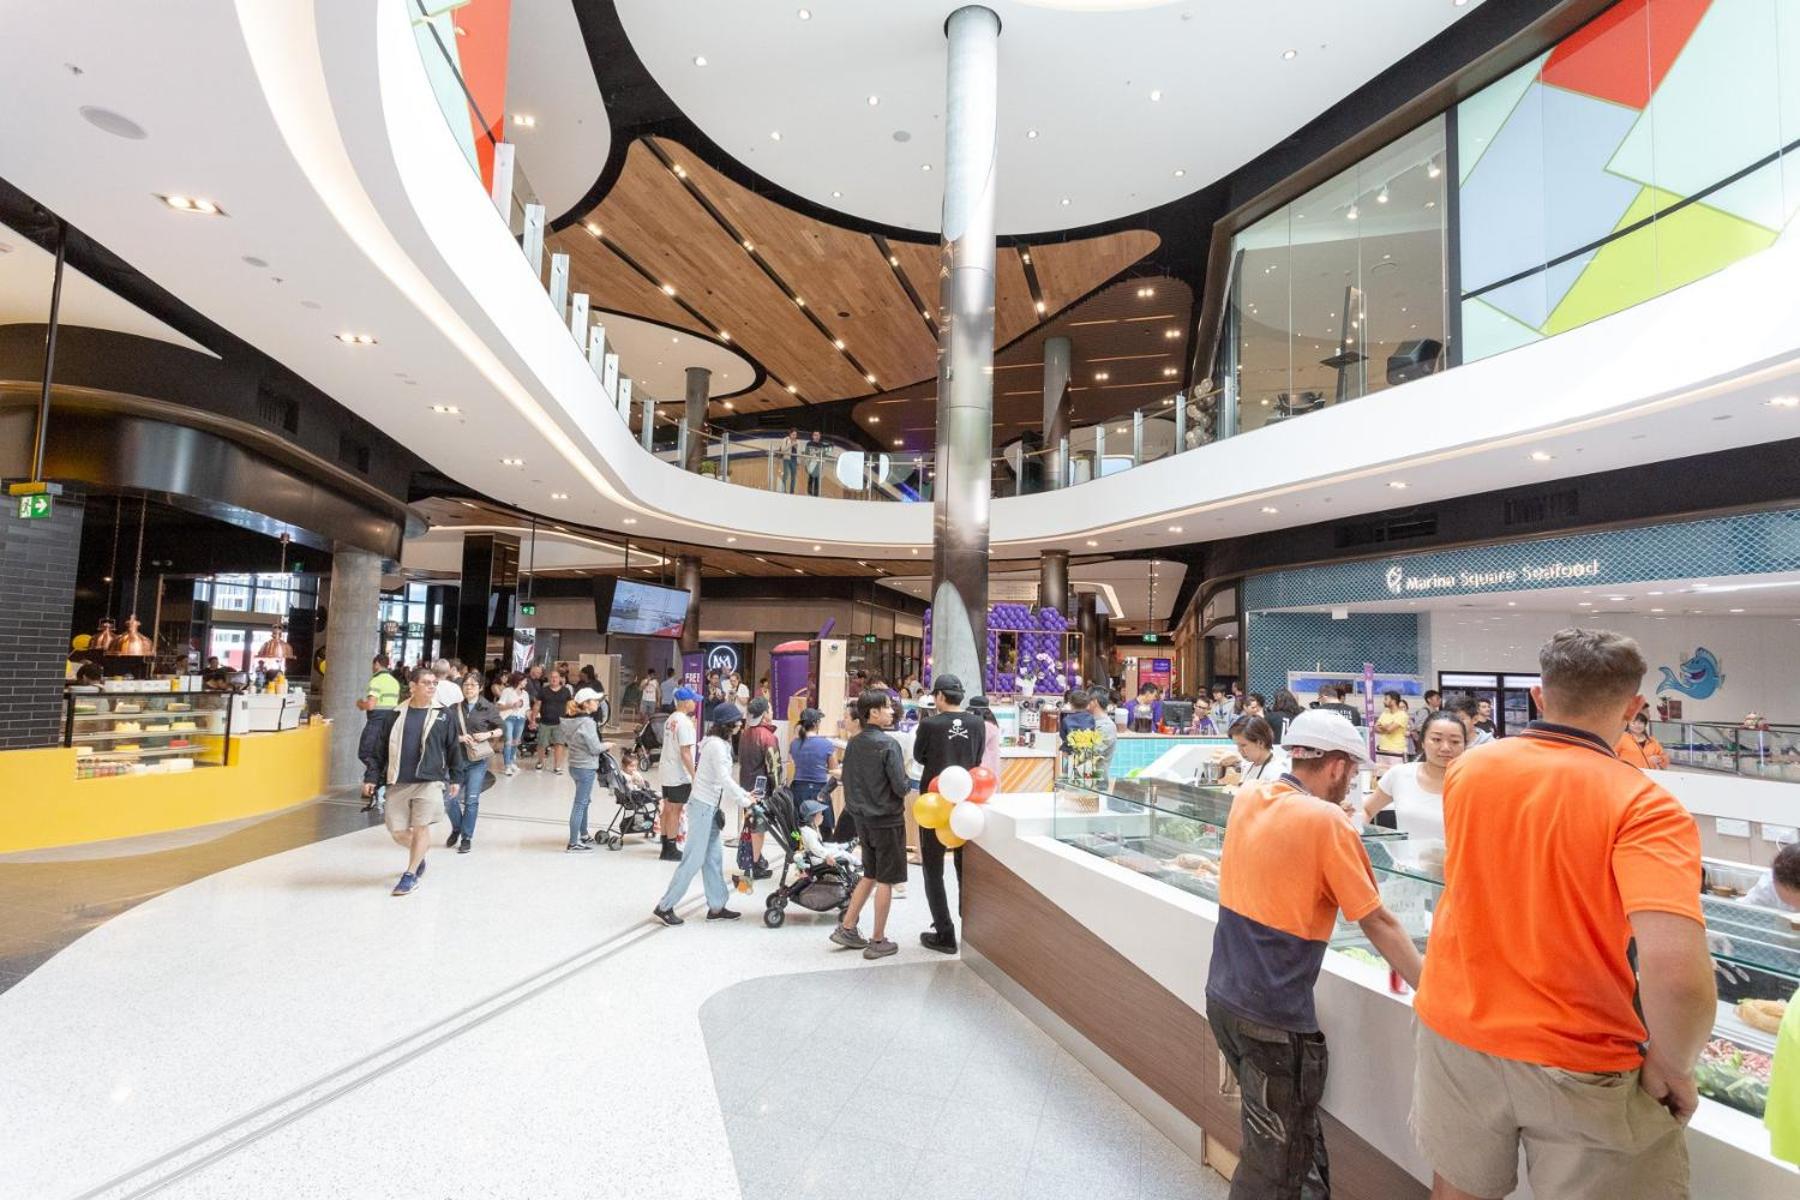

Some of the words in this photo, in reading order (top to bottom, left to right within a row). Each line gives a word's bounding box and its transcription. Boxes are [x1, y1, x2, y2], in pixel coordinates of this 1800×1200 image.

[1406, 573, 1455, 590] Marina
[1460, 570, 1516, 588] Square
[1522, 559, 1600, 580] Seafood
